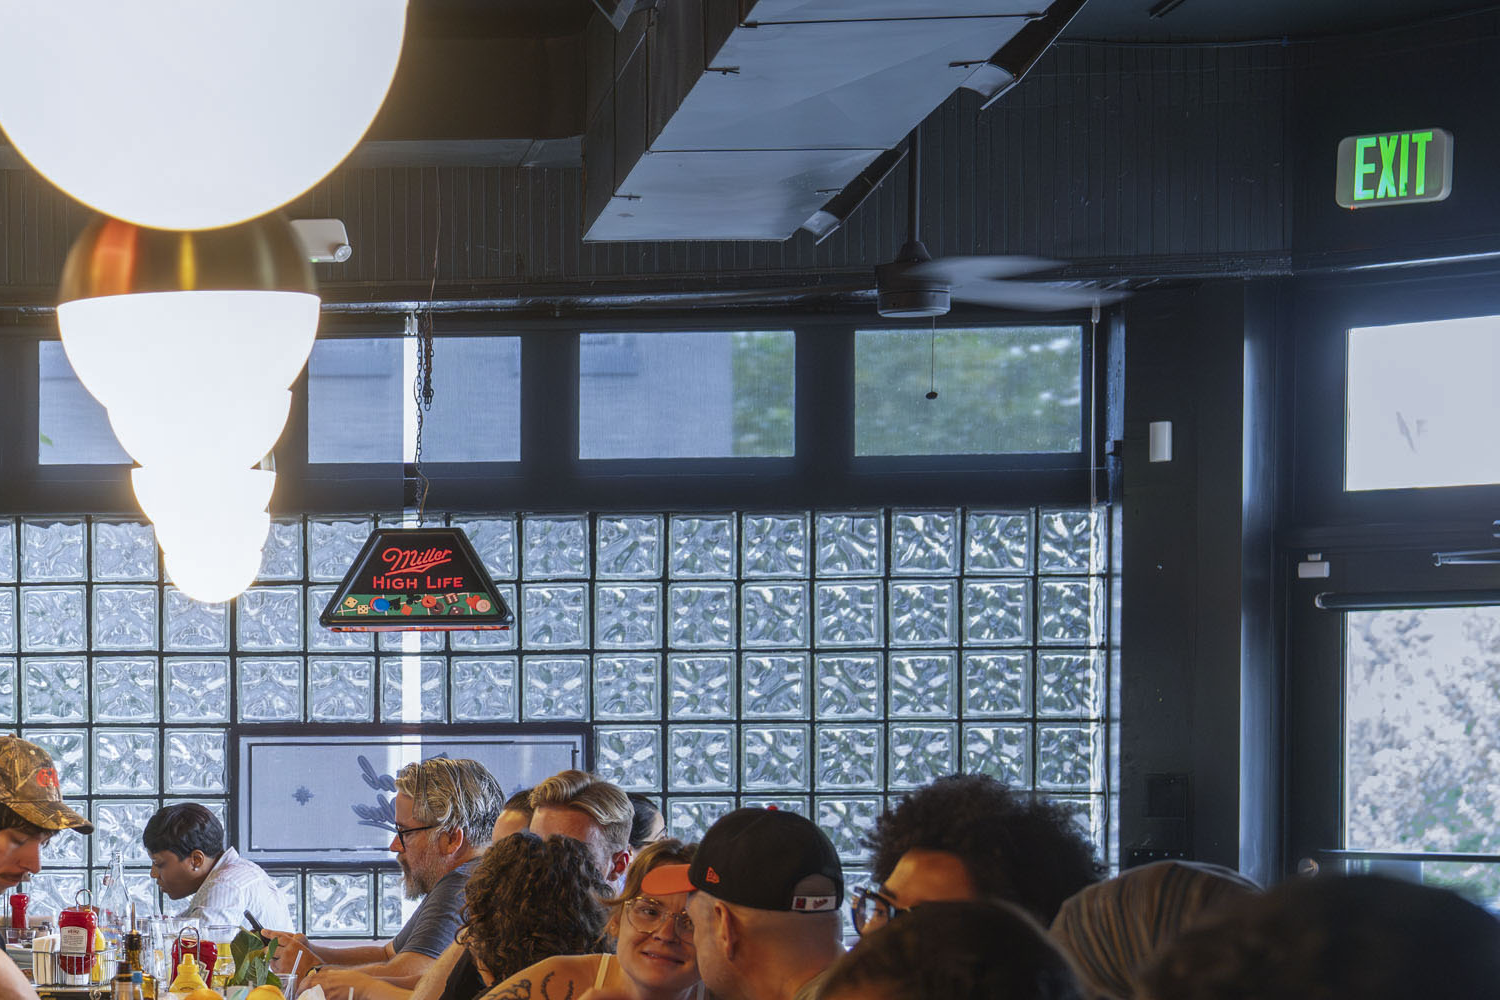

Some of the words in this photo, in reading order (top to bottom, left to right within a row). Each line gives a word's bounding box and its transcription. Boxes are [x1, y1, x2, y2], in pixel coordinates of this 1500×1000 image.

[1354, 131, 1433, 201] EXIT
[382, 547, 452, 573] Miller
[373, 575, 418, 590] HIGH
[426, 575, 464, 589] LIFE
